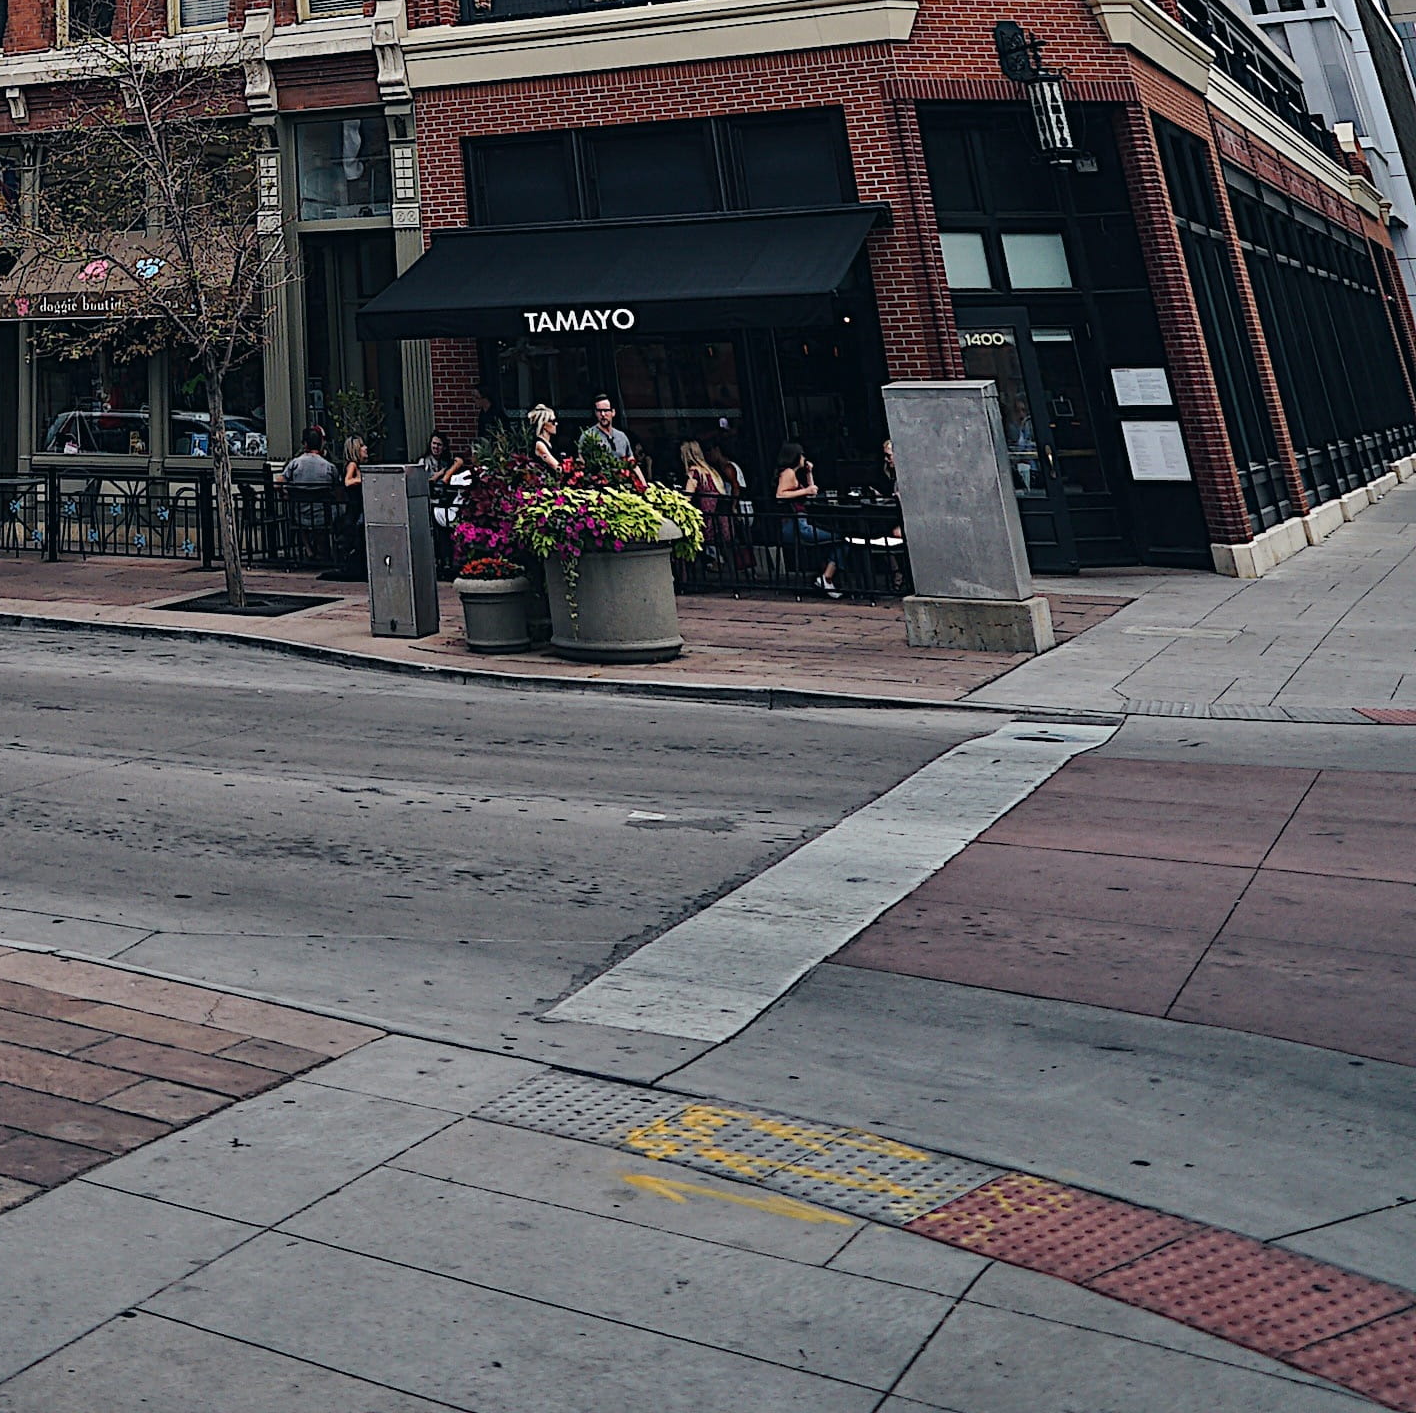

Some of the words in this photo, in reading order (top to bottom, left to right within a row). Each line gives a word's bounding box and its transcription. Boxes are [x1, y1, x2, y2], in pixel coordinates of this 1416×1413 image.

[40, 296, 78, 315] doggie
[523, 308, 635, 333] TAMAYO
[964, 332, 1005, 347] 1400
